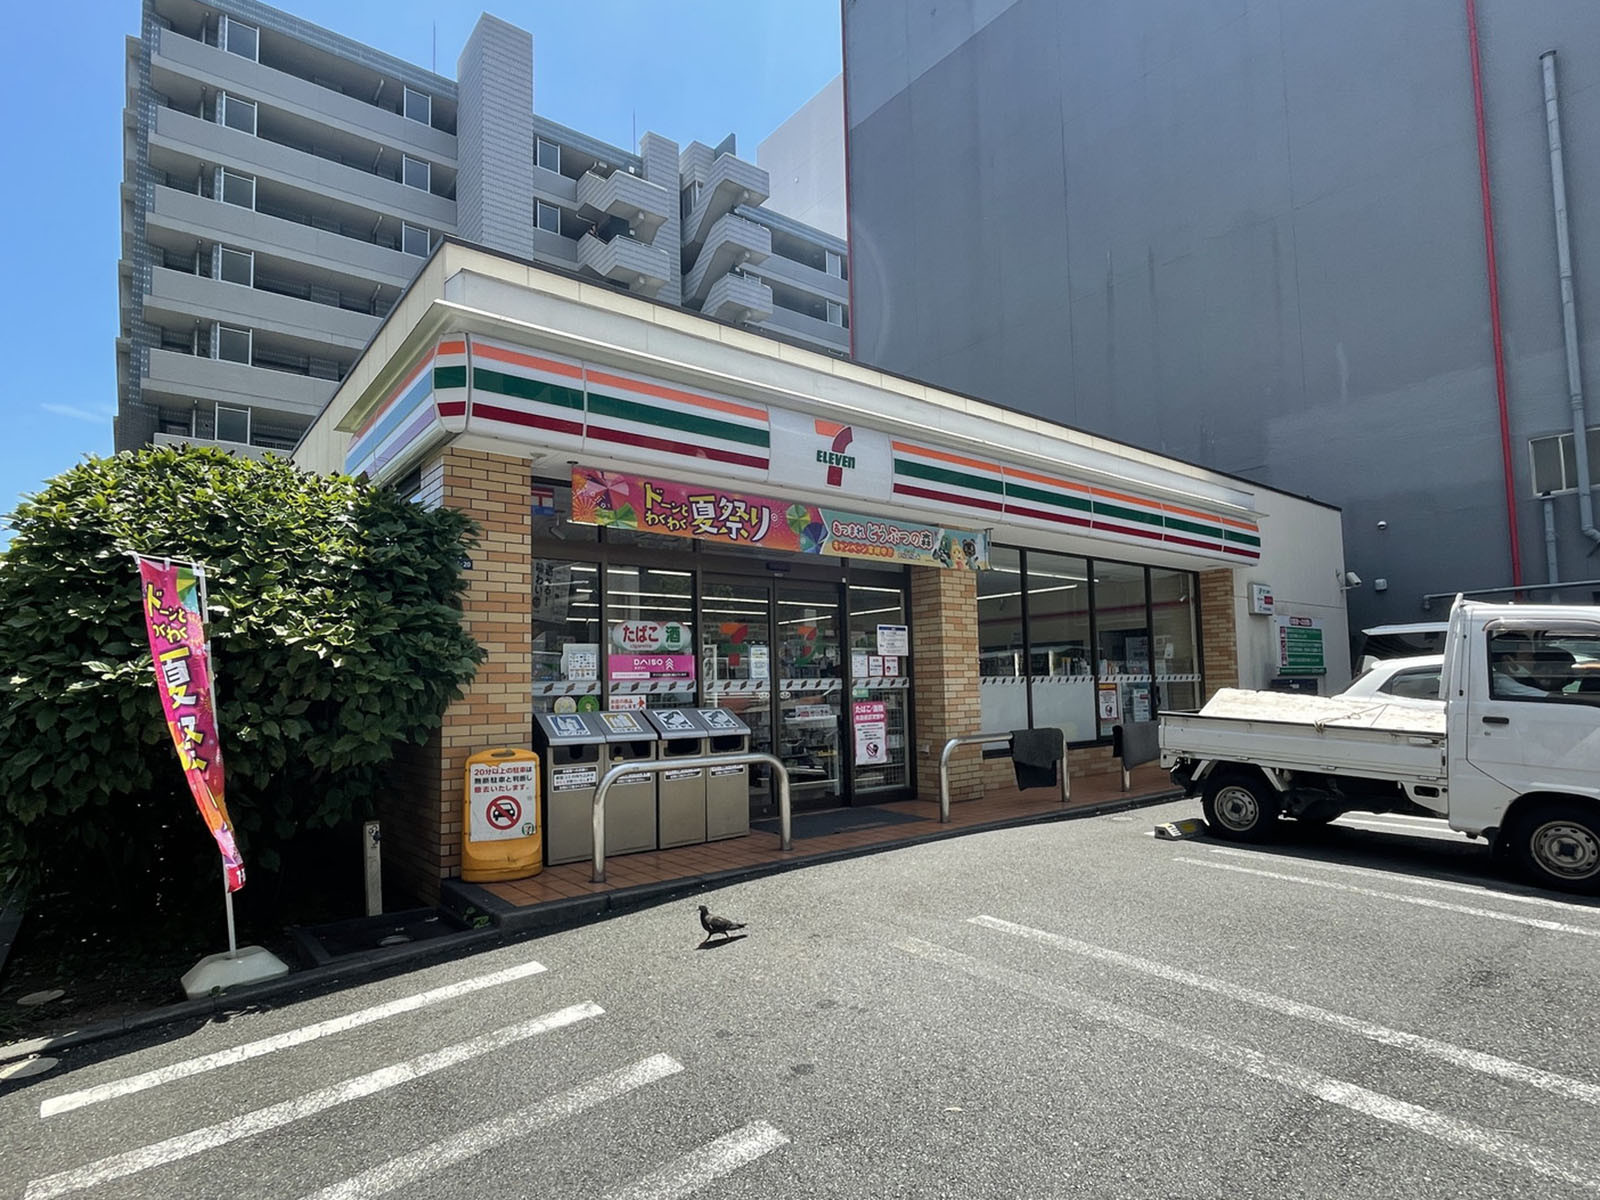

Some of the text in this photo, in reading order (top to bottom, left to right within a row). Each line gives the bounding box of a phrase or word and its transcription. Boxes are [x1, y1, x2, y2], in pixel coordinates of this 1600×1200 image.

[643, 482, 689, 517] ドーンと
[644, 510, 688, 532] わくわく
[689, 493, 771, 542] 夏祭り
[146, 582, 187, 623] ドーンと
[622, 625, 681, 643] たばこ 酒
